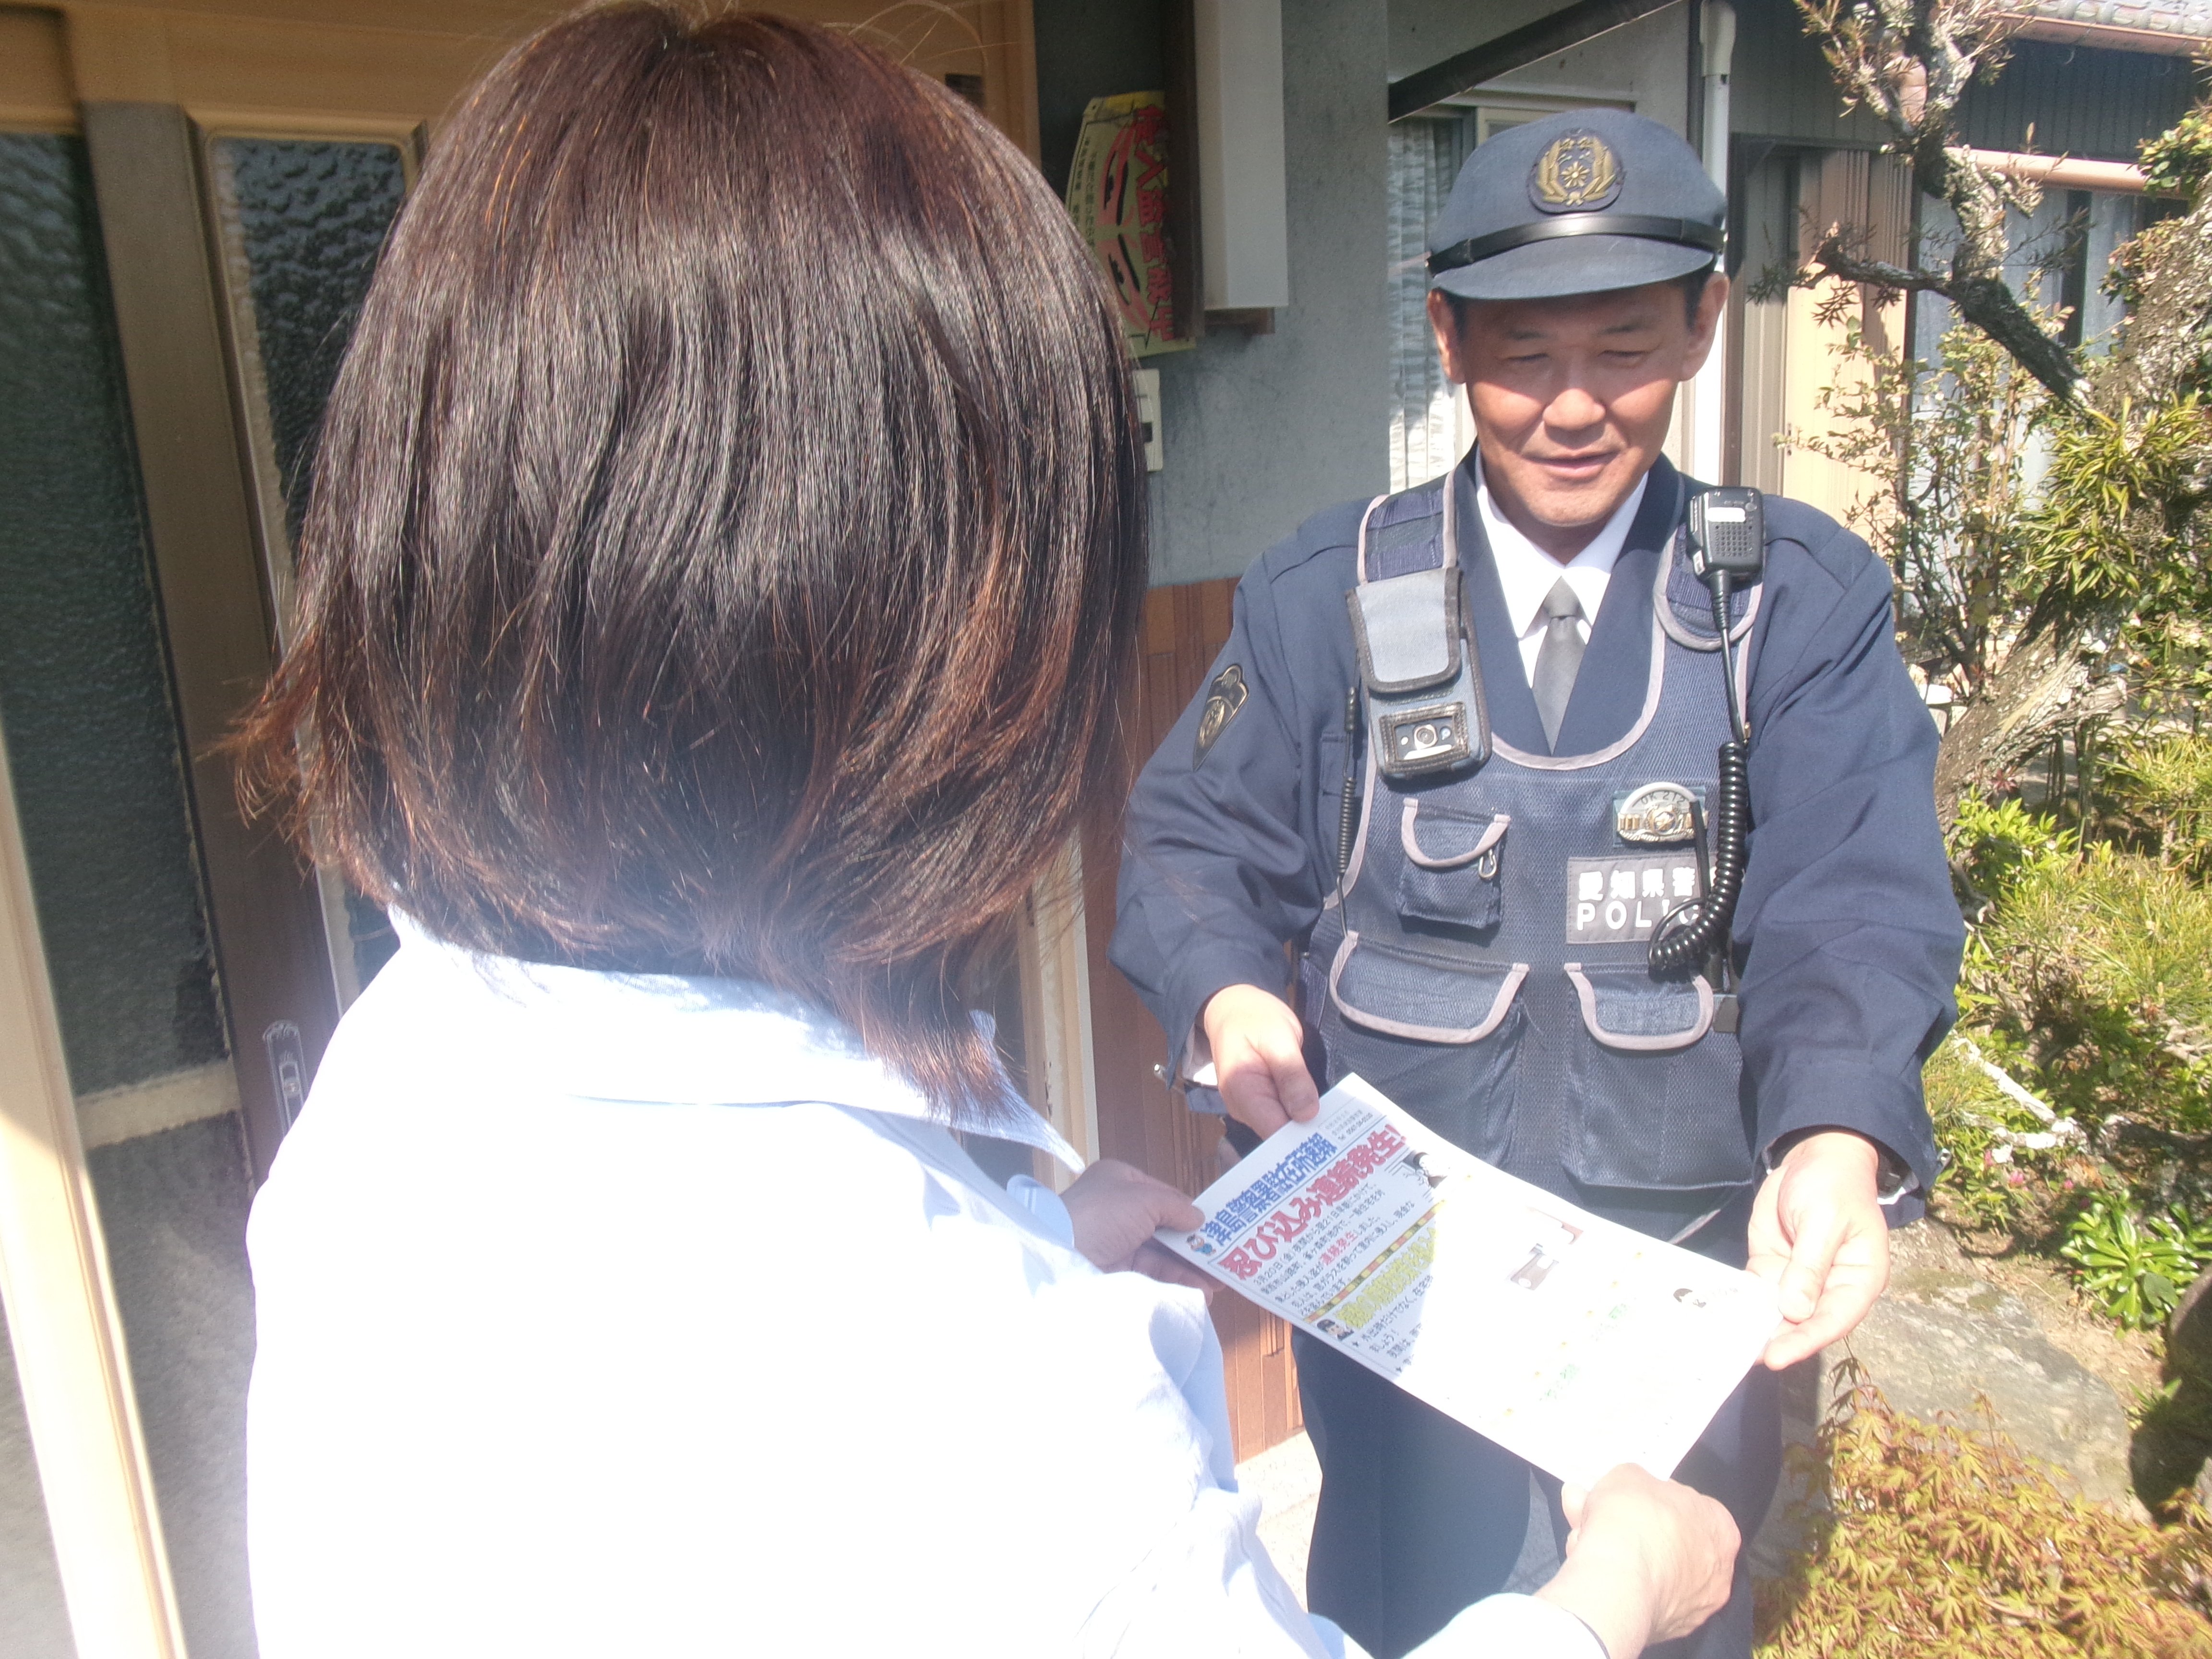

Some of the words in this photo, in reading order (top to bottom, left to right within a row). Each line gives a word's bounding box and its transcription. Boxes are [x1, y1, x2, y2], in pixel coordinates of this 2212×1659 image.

[1579, 867, 1717, 901] 愛知県警
[1577, 898, 1699, 931] POLIC
[1199, 1131, 1340, 1247] 津島警察署駐在所速報
